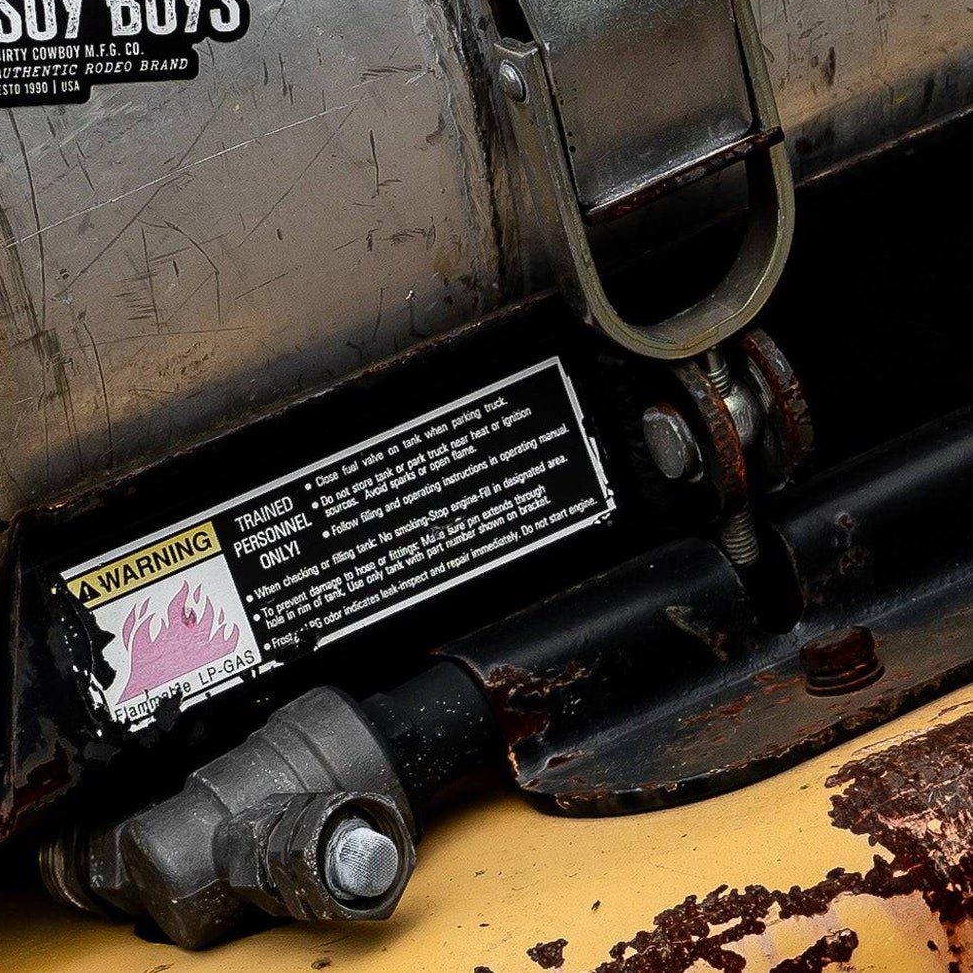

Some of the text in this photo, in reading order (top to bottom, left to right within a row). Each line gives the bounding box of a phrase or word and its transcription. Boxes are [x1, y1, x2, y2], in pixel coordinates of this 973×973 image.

[32, 46, 81, 61] COWBOY
[85, 43, 121, 58] M.F.G.
[126, 42, 144, 55] CO.
[85, 61, 132, 74] RODEO
[140, 58, 188, 71] BRAND
[24, 82, 48, 94] 1990
[61, 80, 80, 92] USA
[315, 397, 507, 487] Close fuel valve on tank when parking truck.
[320, 408, 531, 506] Do not store tank or park truck near heat or ignition
[325, 445, 477, 517] sources. Avoid sparks or open flame.
[331, 423, 569, 535] Follow filling and operating instructions in operating manual.
[233, 513, 312, 557] PERSONNEL
[235, 497, 293, 531] TRAINED
[254, 583, 281, 599] When
[283, 565, 319, 587] checking
[321, 560, 330, 569] or
[332, 549, 355, 565] filling
[378, 532, 393, 543] No
[395, 507, 449, 537] smoking-Stop
[451, 486, 491, 511] engine-Fill
[492, 483, 501, 493] in
[503, 461, 546, 488] designated
[547, 455, 568, 469] area.
[98, 532, 212, 592] WARNING
[260, 607, 274, 617] To
[276, 591, 308, 615] prevent
[309, 577, 342, 597] damage
[344, 572, 354, 581] to
[355, 562, 376, 576] hose
[378, 556, 386, 566] or
[446, 522, 465, 535] sure
[467, 515, 480, 528] pin
[482, 499, 513, 519] extends
[514, 484, 545, 505] through
[260, 541, 301, 569] ONLY!
[266, 615, 285, 629] hole
[286, 611, 295, 620] in
[297, 603, 311, 615] rim
[313, 595, 322, 607] of
[347, 579, 364, 592] Use
[367, 570, 383, 584] only
[385, 560, 404, 575] tank
[405, 551, 425, 565] with
[427, 543, 444, 559] part
[446, 529, 475, 548] number
[478, 517, 505, 534] shown
[507, 511, 518, 521] on
[518, 495, 551, 515] bracket.
[305, 618, 323, 628] PG
[323, 610, 341, 625] odor
[343, 594, 380, 615] indicates
[380, 571, 429, 599] leak-inspect
[430, 562, 445, 577] and
[446, 552, 469, 569] repair
[470, 531, 521, 558] immediately.
[521, 525, 533, 535] Do
[535, 517, 549, 530] not
[549, 509, 568, 523] start
[569, 498, 597, 514] engine.
[199, 650, 254, 685] LP-GAS
